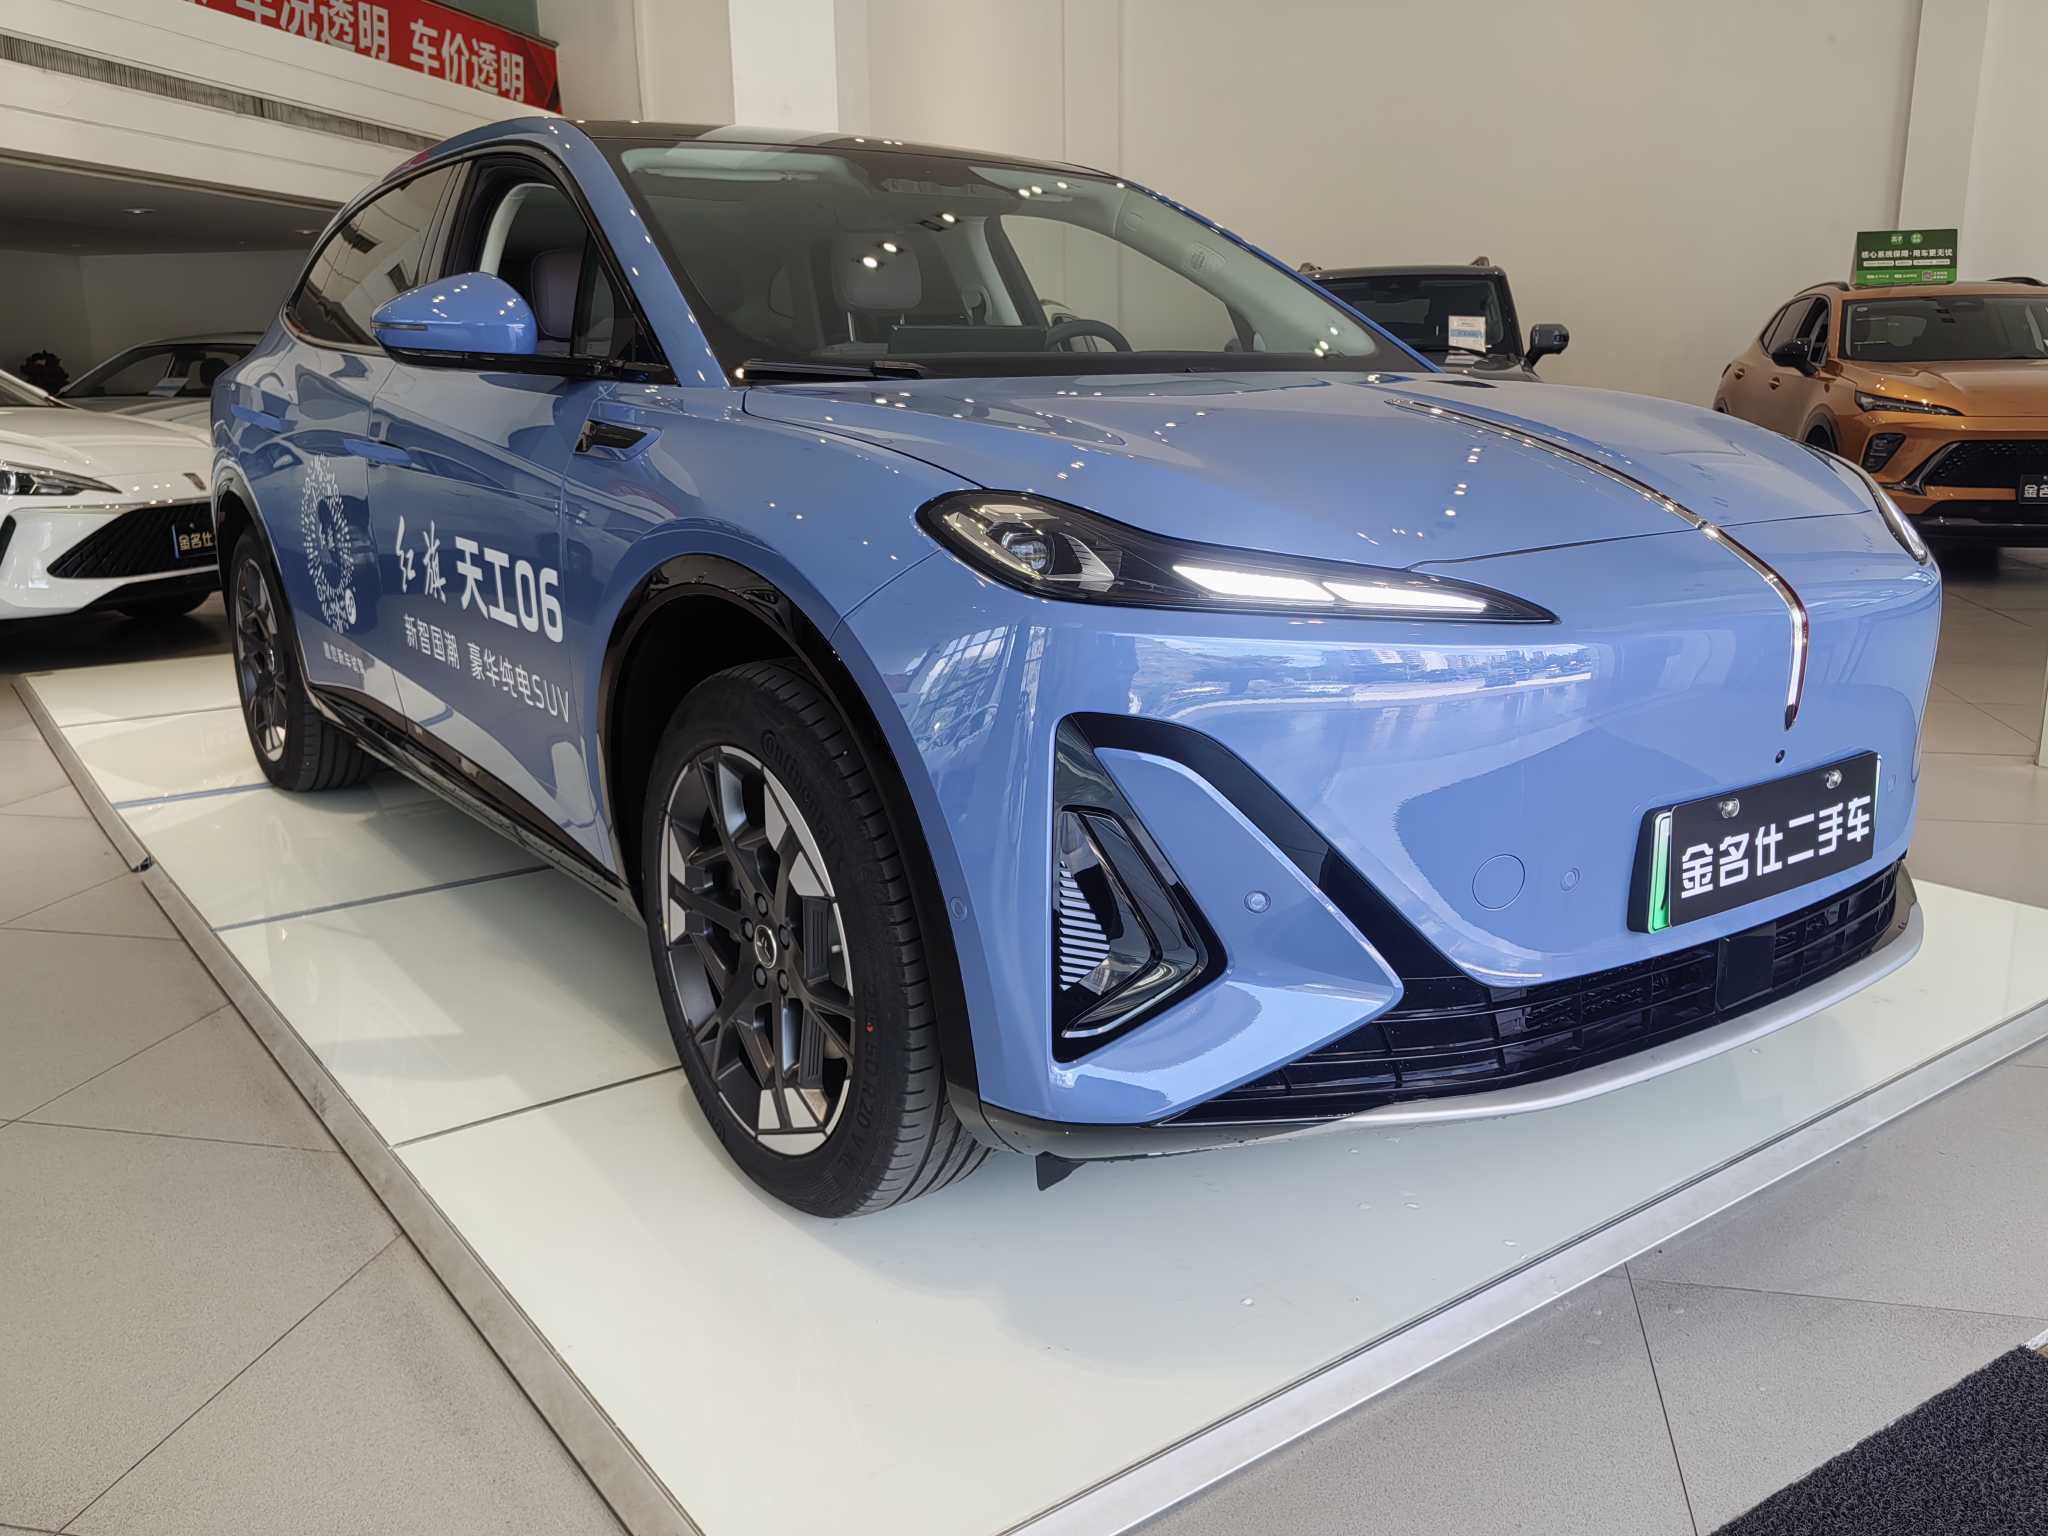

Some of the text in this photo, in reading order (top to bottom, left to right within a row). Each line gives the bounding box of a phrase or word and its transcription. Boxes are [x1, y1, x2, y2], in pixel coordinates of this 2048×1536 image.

[409, 18, 525, 103] 车价透明
[455, 535, 563, 643] 天工06
[467, 641, 569, 724] 豪华纯电SUV
[1681, 795, 1871, 899] 金名仕二手车
